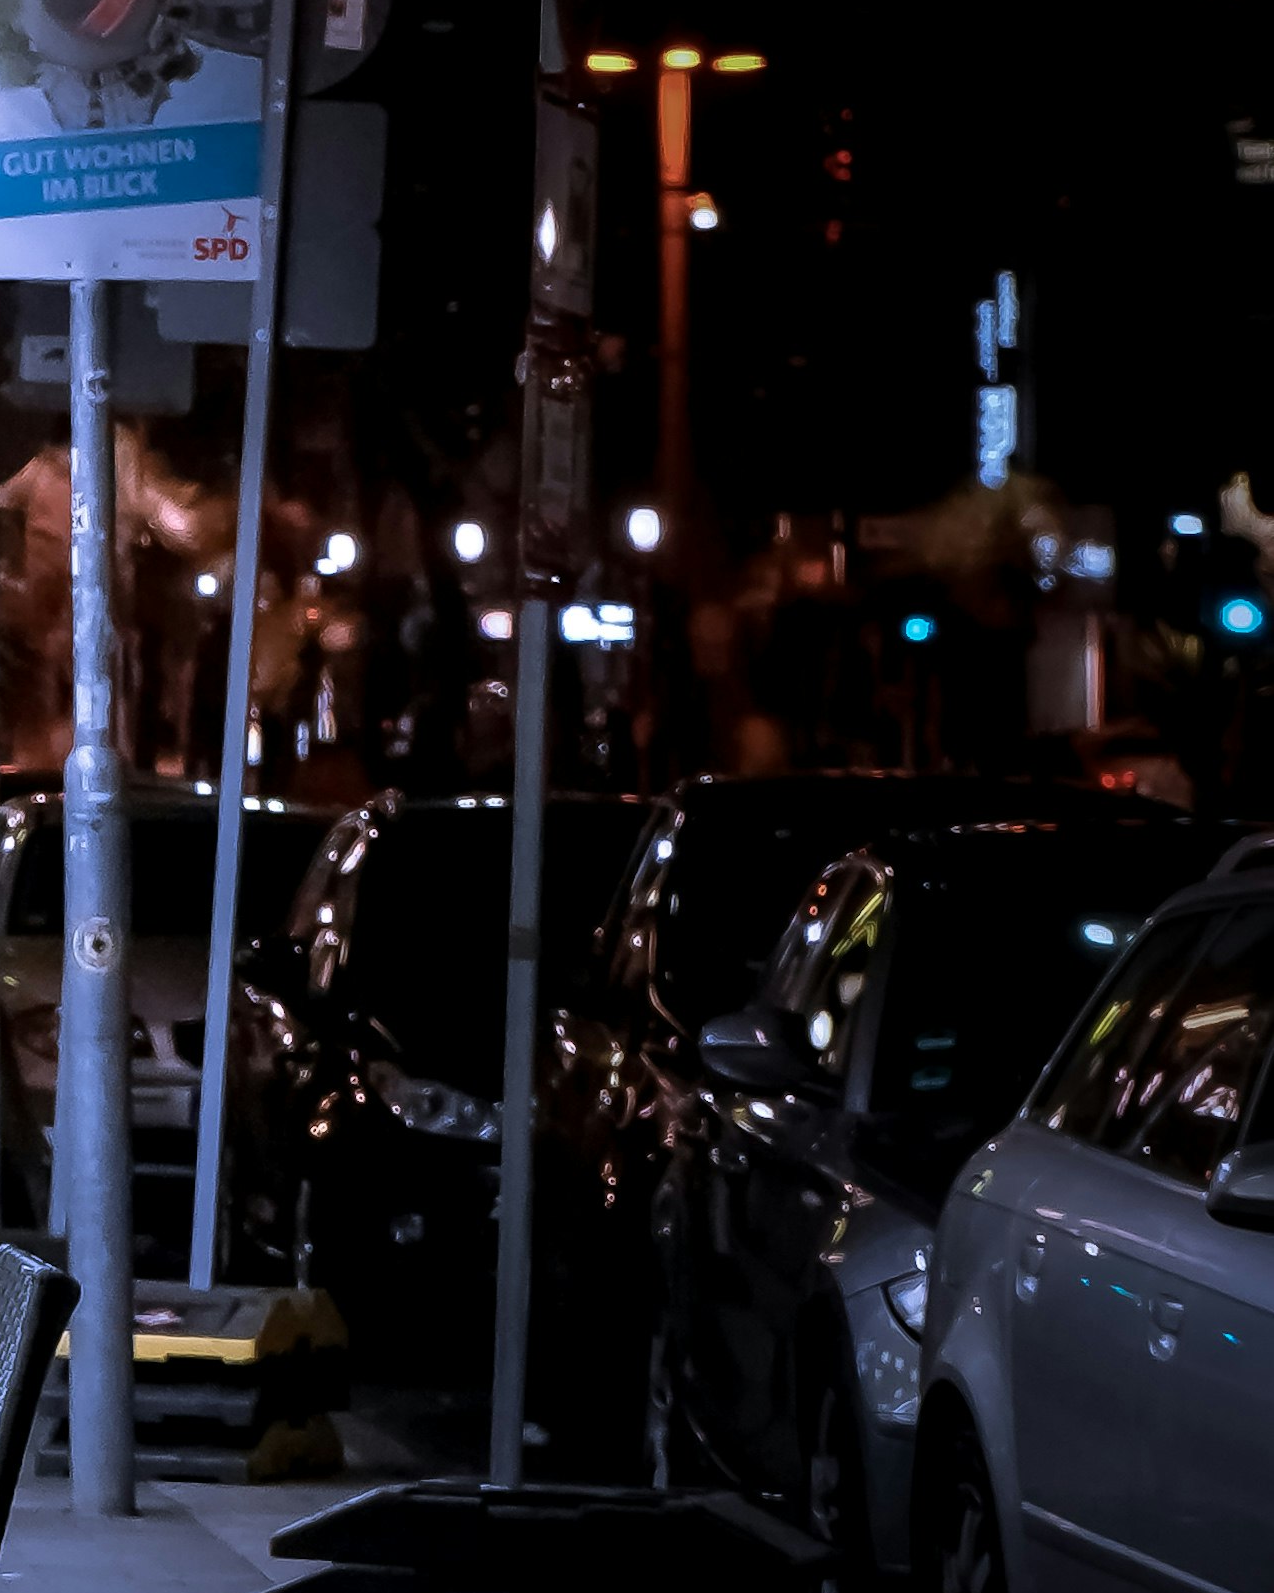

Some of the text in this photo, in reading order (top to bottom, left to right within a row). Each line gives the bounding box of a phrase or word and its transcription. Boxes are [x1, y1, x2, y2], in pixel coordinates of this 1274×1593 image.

[3, 138, 196, 177] GUT WOHNEN
[42, 170, 158, 202] IM BLICK
[193, 237, 250, 261] SPD
